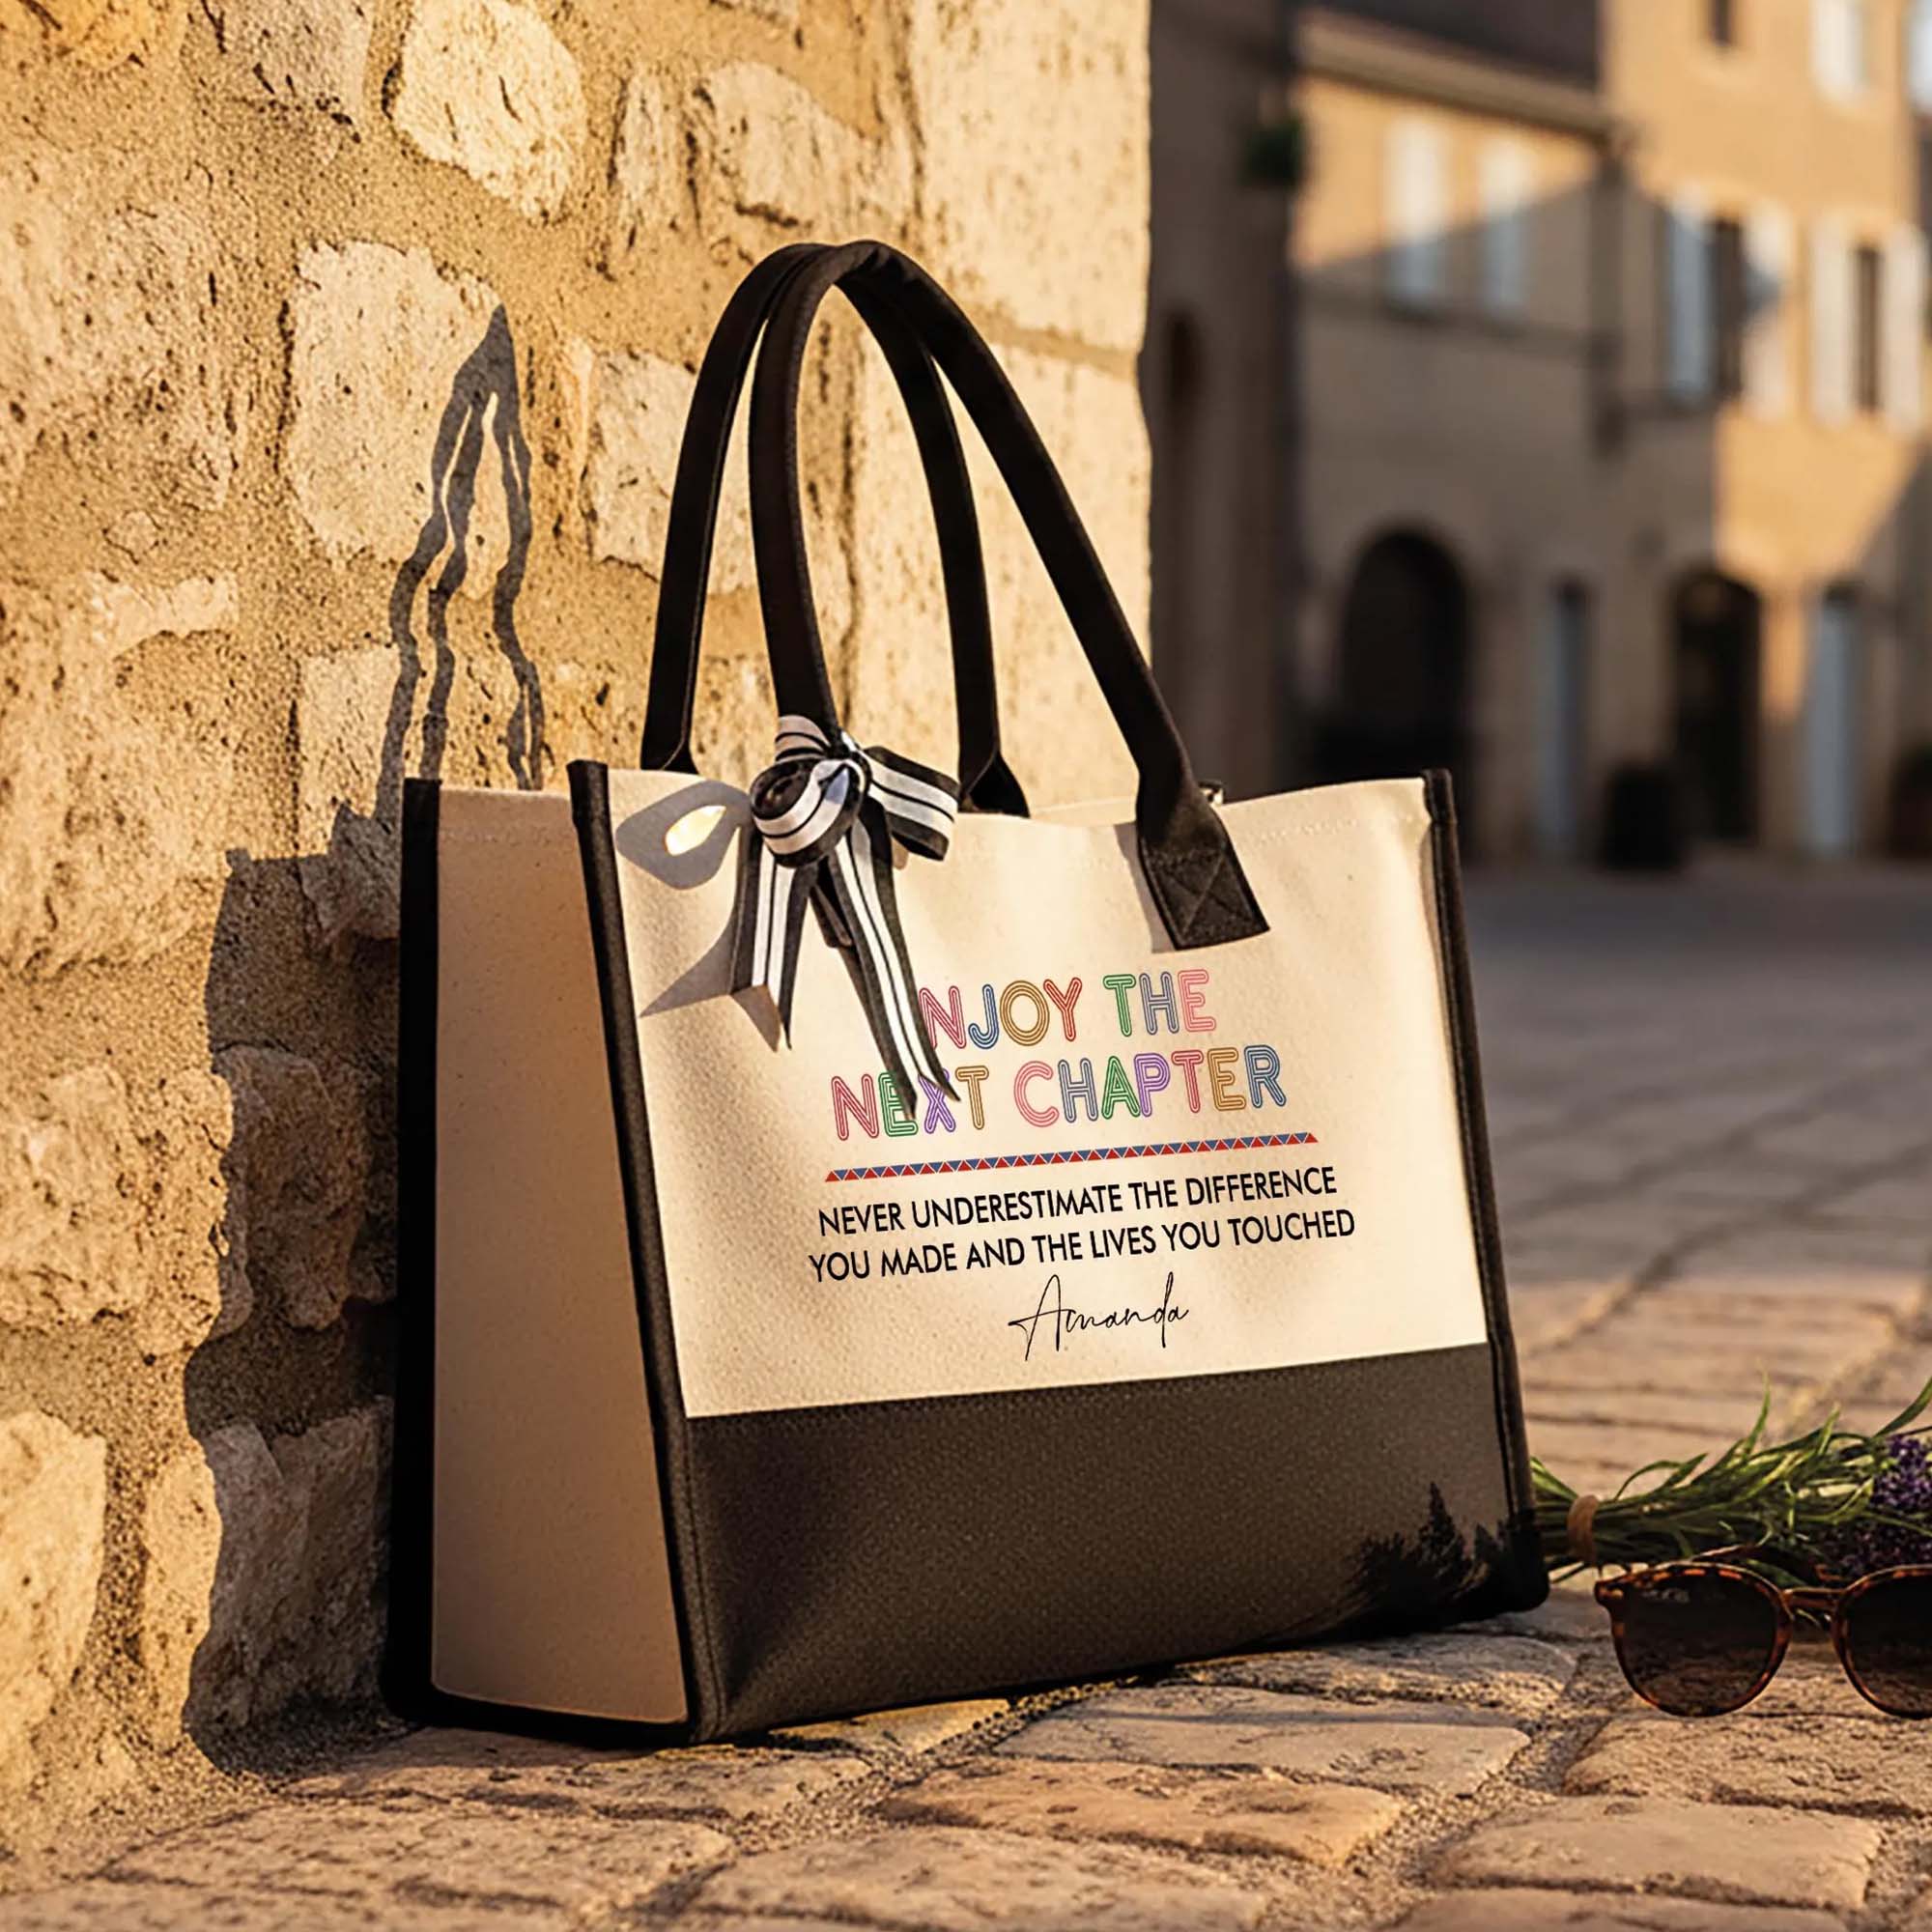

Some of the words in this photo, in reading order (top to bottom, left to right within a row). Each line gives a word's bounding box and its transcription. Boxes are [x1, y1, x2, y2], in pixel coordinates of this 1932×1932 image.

[919, 977, 1083, 1050] NJOY
[1103, 969, 1216, 1037] THE
[831, 1065, 990, 1142] NEXT
[1013, 1044, 1287, 1128] CHAPTER
[819, 1202, 906, 1237] NEVER
[912, 1184, 1124, 1229] UNDERESTIMATE
[1127, 1179, 1179, 1210] THE
[1185, 1166, 1338, 1207] DIFFERENCE
[807, 1250, 870, 1283] YOU
[880, 1242, 958, 1278] MADE
[965, 1237, 1026, 1270] AND
[1030, 1232, 1084, 1264] THE
[1090, 1225, 1157, 1260] LIVES
[1161, 1220, 1221, 1252] YOU
[1227, 1209, 1355, 1247] TOUCHED
[1008, 1271, 1190, 1361] Amanda
